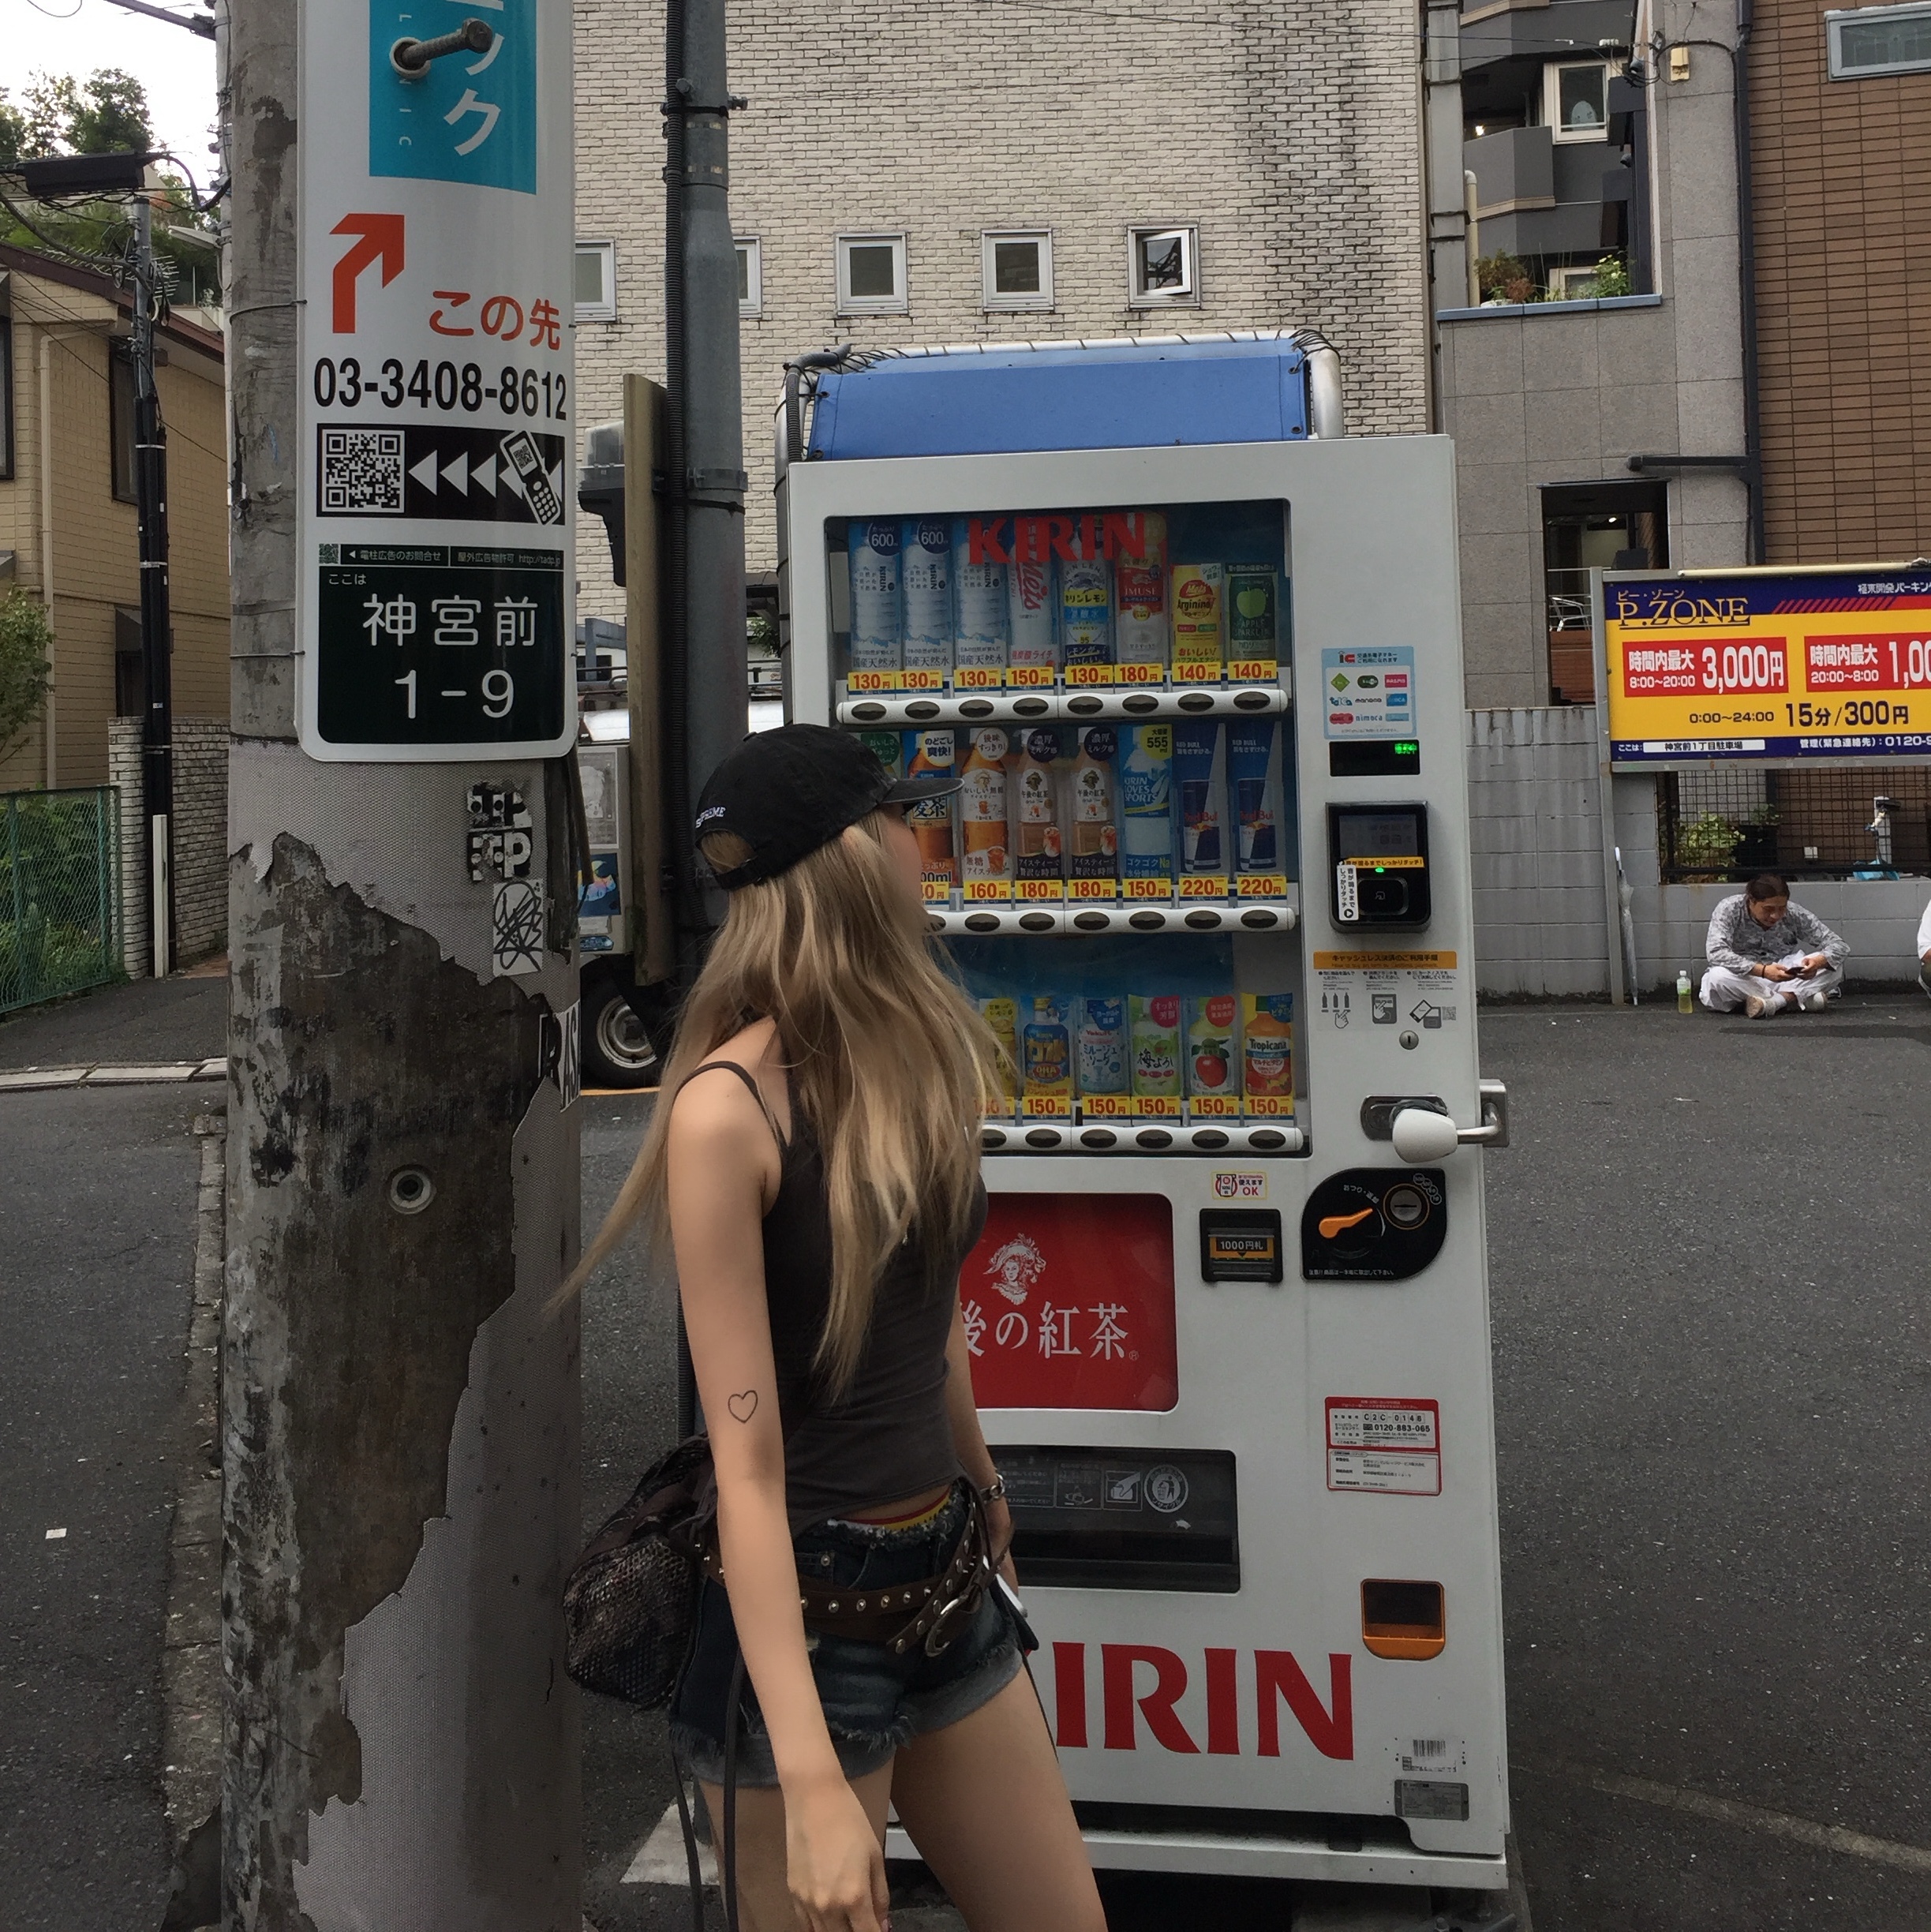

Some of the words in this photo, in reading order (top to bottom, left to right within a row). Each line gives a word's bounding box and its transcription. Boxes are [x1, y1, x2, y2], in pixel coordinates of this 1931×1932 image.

[429, 290, 561, 350] この先
[314, 358, 567, 421] 03-3408-8612
[871, 534, 894, 547] 600
[921, 532, 944, 545] 600
[969, 510, 1146, 566] KIRIN
[328, 574, 367, 586] ここは
[1858, 582, 1931, 594] 極東開発パーキン
[1618, 590, 1685, 601] ピー・ゾーン
[362, 593, 538, 647] 神宮前
[1616, 597, 1749, 628] P.ZONE
[958, 653, 1004, 665] 国産天然水
[1628, 650, 1695, 672] 時間内最大
[1809, 643, 1878, 667] 時間内最大
[960, 670, 997, 686] 130円
[1011, 669, 1049, 685] 150円
[1071, 667, 1109, 683] 130円
[1120, 665, 1158, 682] 180円
[1177, 664, 1216, 680] 140円
[1233, 663, 1272, 679] 140円
[1702, 646, 1785, 695] 3,000円
[854, 673, 891, 690] 130円
[901, 672, 938, 688] 130円
[395, 669, 515, 719] 1-9
[1786, 700, 1910, 727] 15分/300円
[925, 736, 953, 745] のどごし
[1091, 732, 1111, 743] 濃厚
[1147, 736, 1168, 749] 555
[927, 746, 951, 757] 爽快!
[1664, 741, 1743, 751] 神宮前1丁目駐車場
[922, 861, 947, 870] っぷり
[967, 856, 984, 867] 無糖
[1127, 858, 1158, 867] ゴクゴク
[921, 871, 952, 882] 00ml
[922, 884, 945, 899] 0円
[970, 883, 1007, 899] 160円
[1020, 882, 1058, 897] 180円
[1073, 881, 1111, 897] 180円
[1128, 880, 1166, 897] 150円
[1184, 879, 1222, 895] 220円
[1241, 878, 1282, 895] 220円
[1249, 1038, 1286, 1051] Tropicana
[1028, 1098, 1066, 1114] 150円
[1087, 1098, 1126, 1114] 150円
[1136, 1098, 1176, 1114] 150円
[1196, 1098, 1234, 1114] 150円
[1248, 1098, 1288, 1114] 150円
[1242, 1186, 1259, 1196] OK
[1220, 1240, 1264, 1250] 1000円札
[961, 1299, 1129, 1361] 後の紅茶
[1374, 1424, 1431, 1432] 0120-883-065
[1050, 1642, 1354, 1761] IRIN
